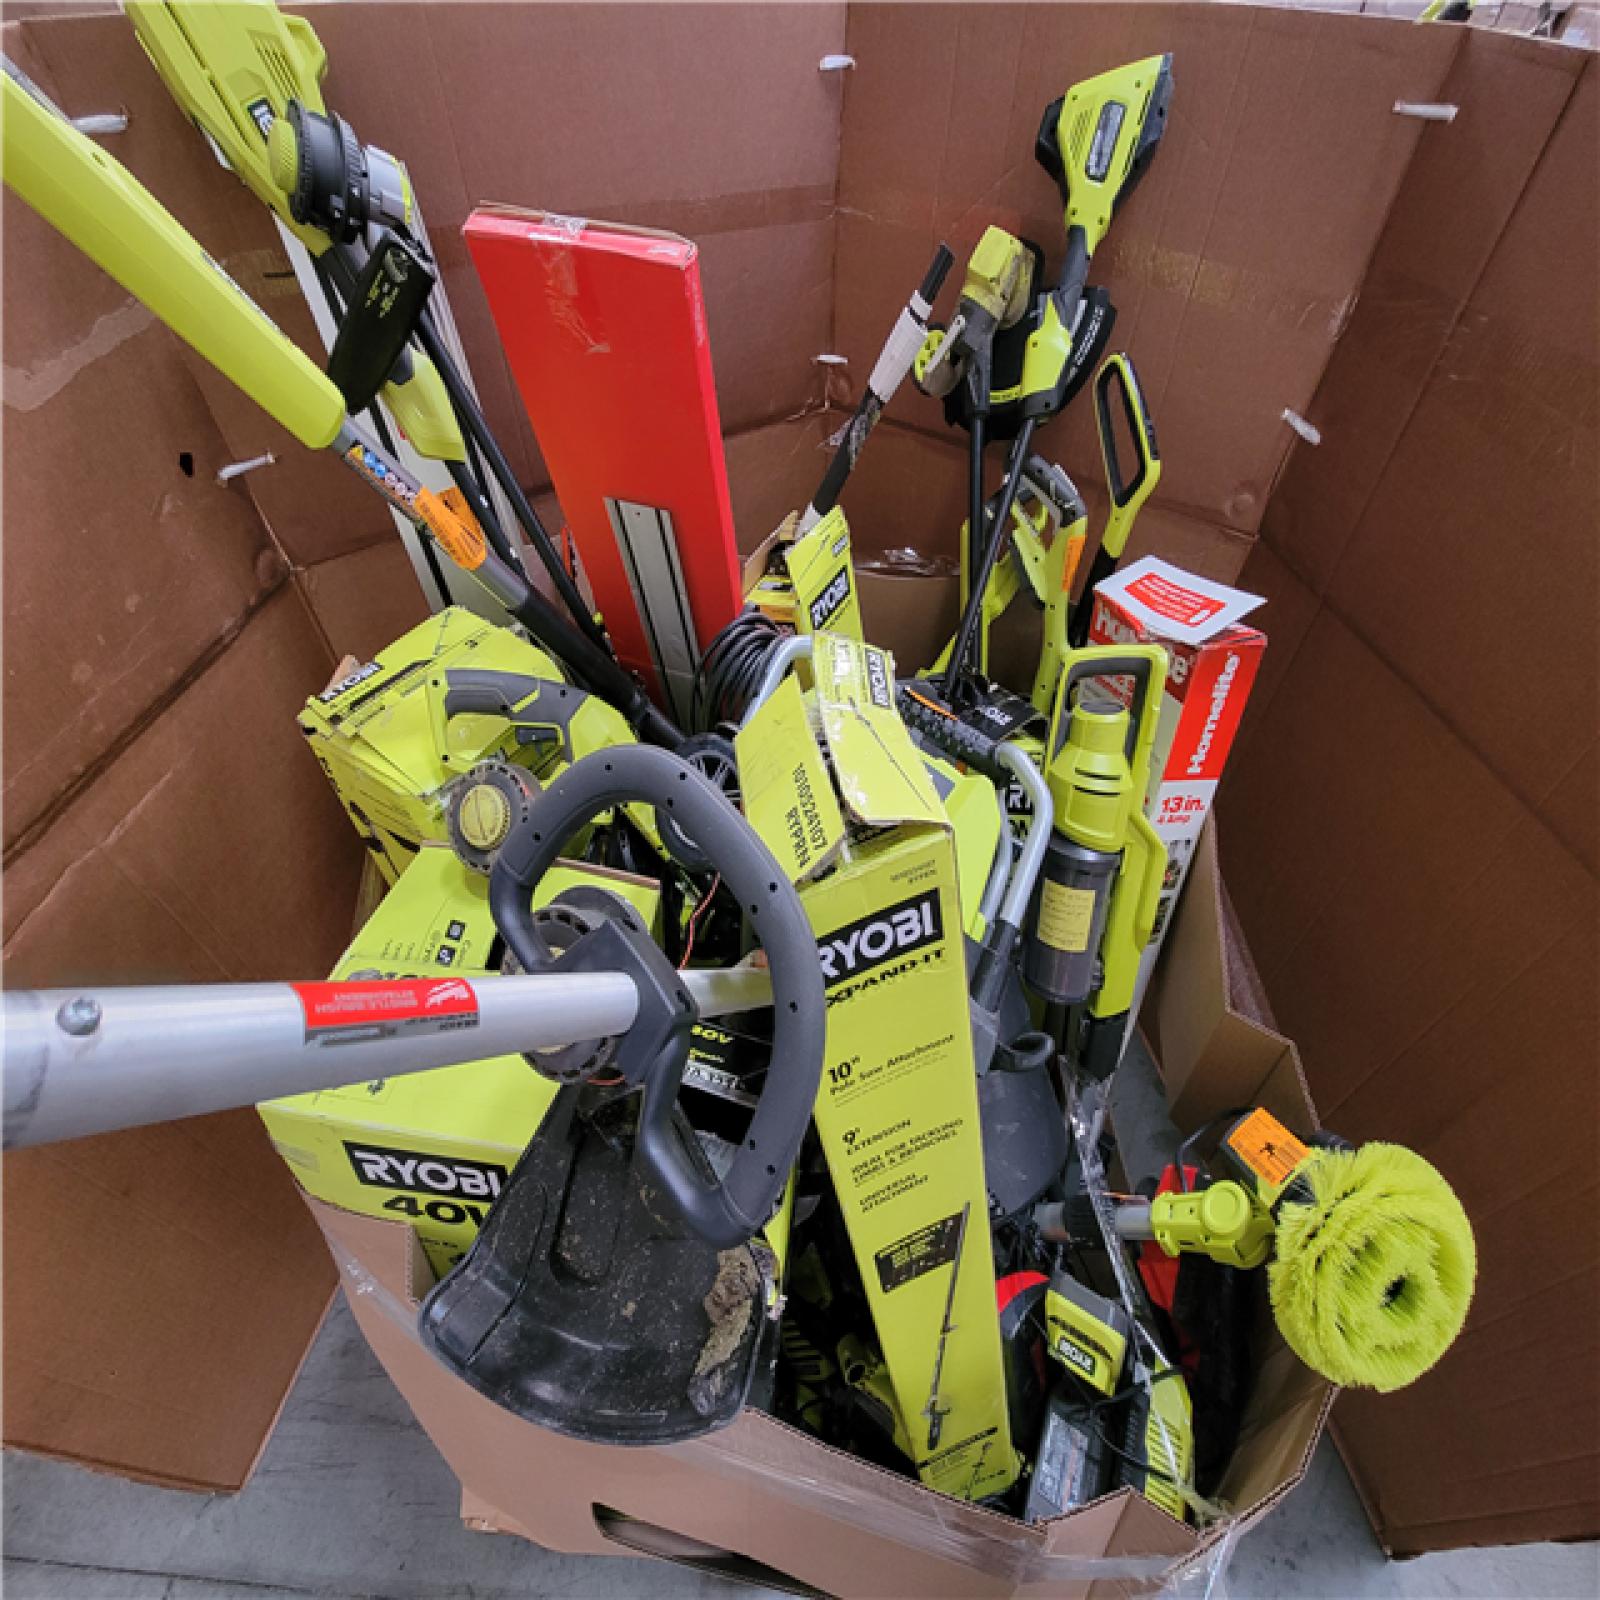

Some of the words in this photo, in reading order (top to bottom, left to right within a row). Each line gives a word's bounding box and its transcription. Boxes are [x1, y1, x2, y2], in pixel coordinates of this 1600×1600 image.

[1187, 655, 1240, 775] Homelite
[1162, 795, 1183, 814] 13
[819, 901, 933, 979] RYOBI
[859, 1065, 883, 1081] Saw
[886, 1034, 954, 1068] Attachment
[846, 1119, 911, 1156] EXTENSION
[852, 1154, 881, 1174] IDEAL
[884, 1142, 906, 1157] FOR
[353, 1150, 501, 1199] RYOBI
[859, 1173, 916, 1206] UNIVERSAL
